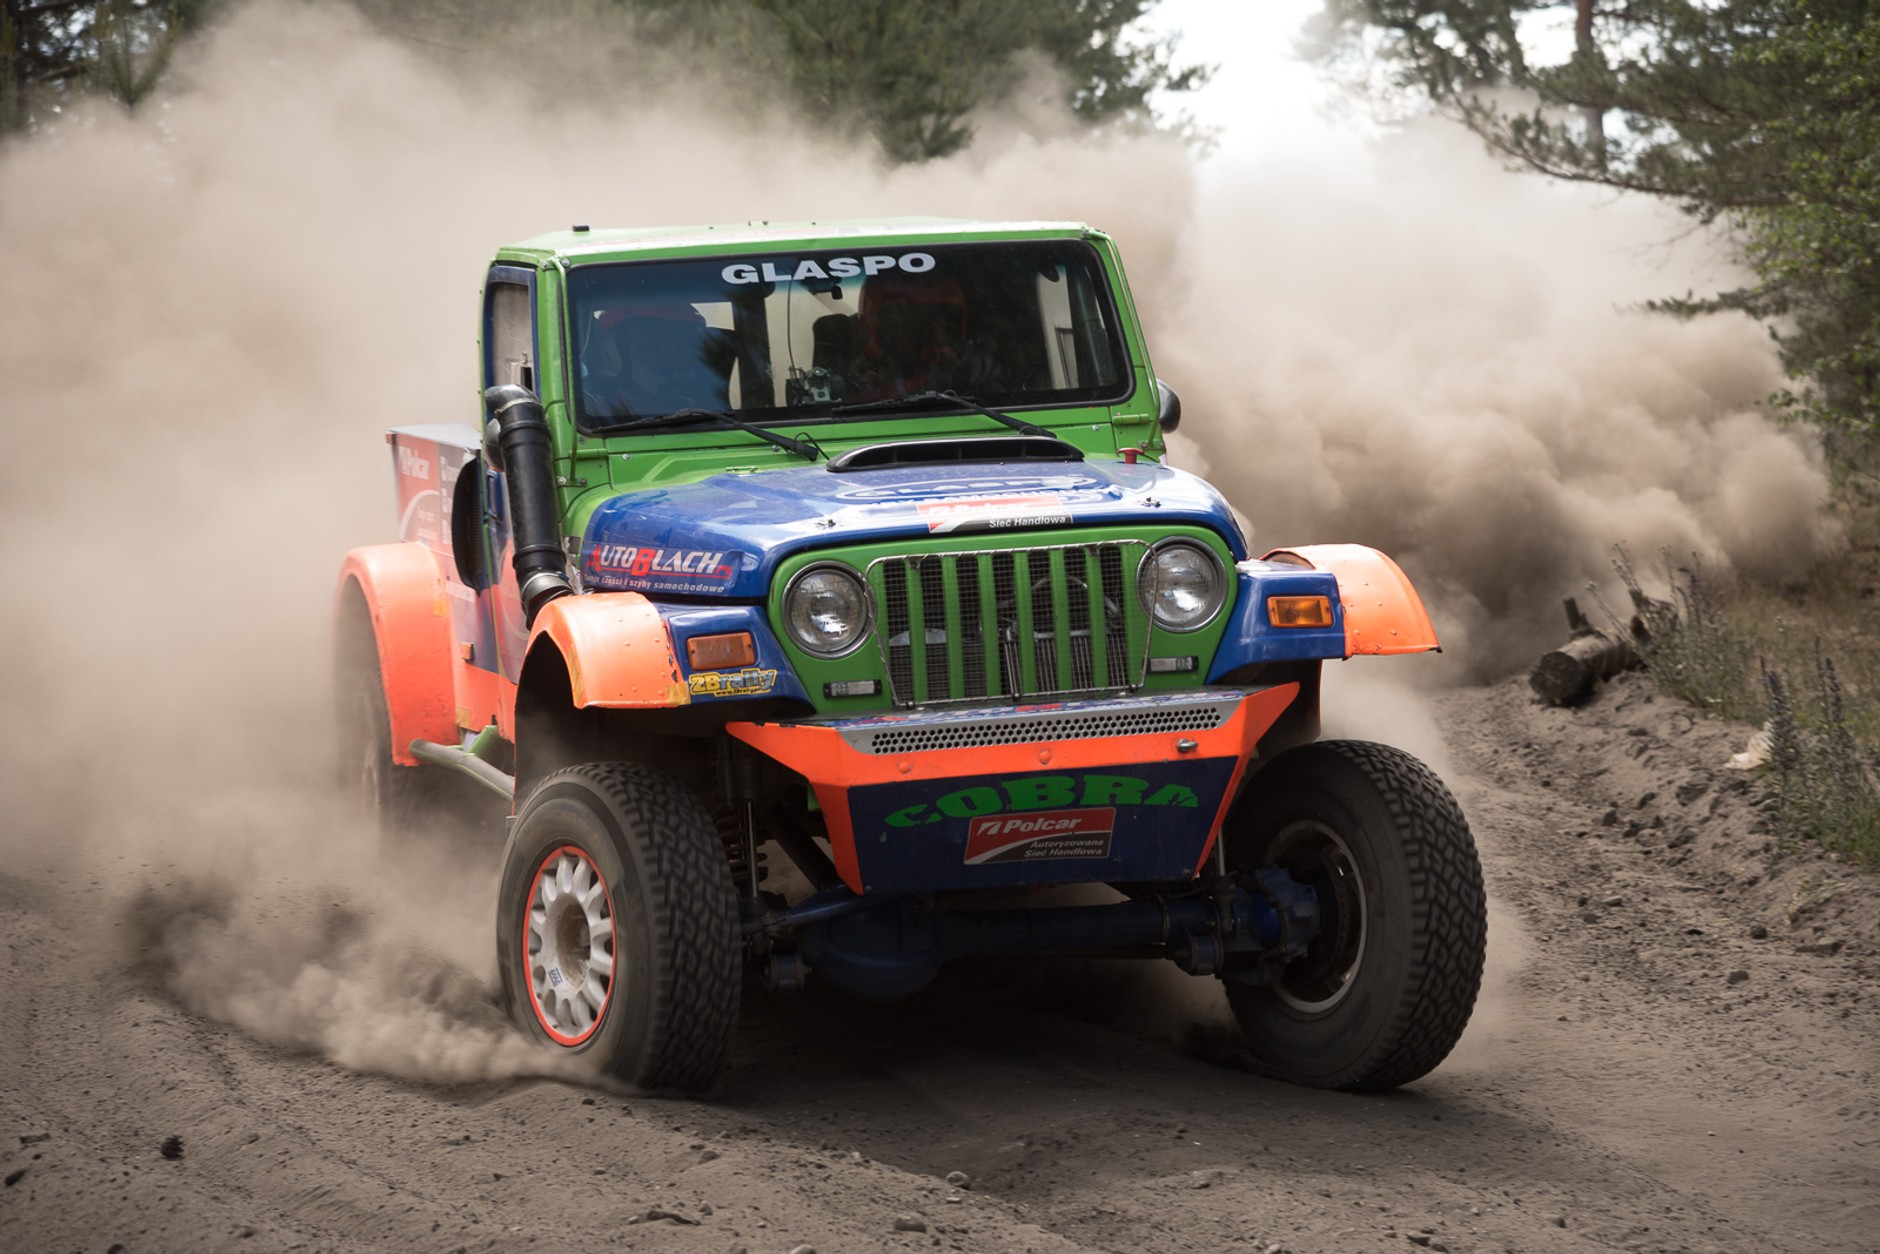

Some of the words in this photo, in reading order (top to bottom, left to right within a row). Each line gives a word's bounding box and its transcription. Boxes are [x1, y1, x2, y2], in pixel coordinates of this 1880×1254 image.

[721, 252, 936, 284] GLASPO
[1014, 515, 1066, 526] Handlowa
[884, 774, 1199, 828] COBRA
[1002, 817, 1082, 834] Polcar
[1030, 839, 1104, 849] Autoryzowana
[1048, 847, 1103, 857] Handlowa
